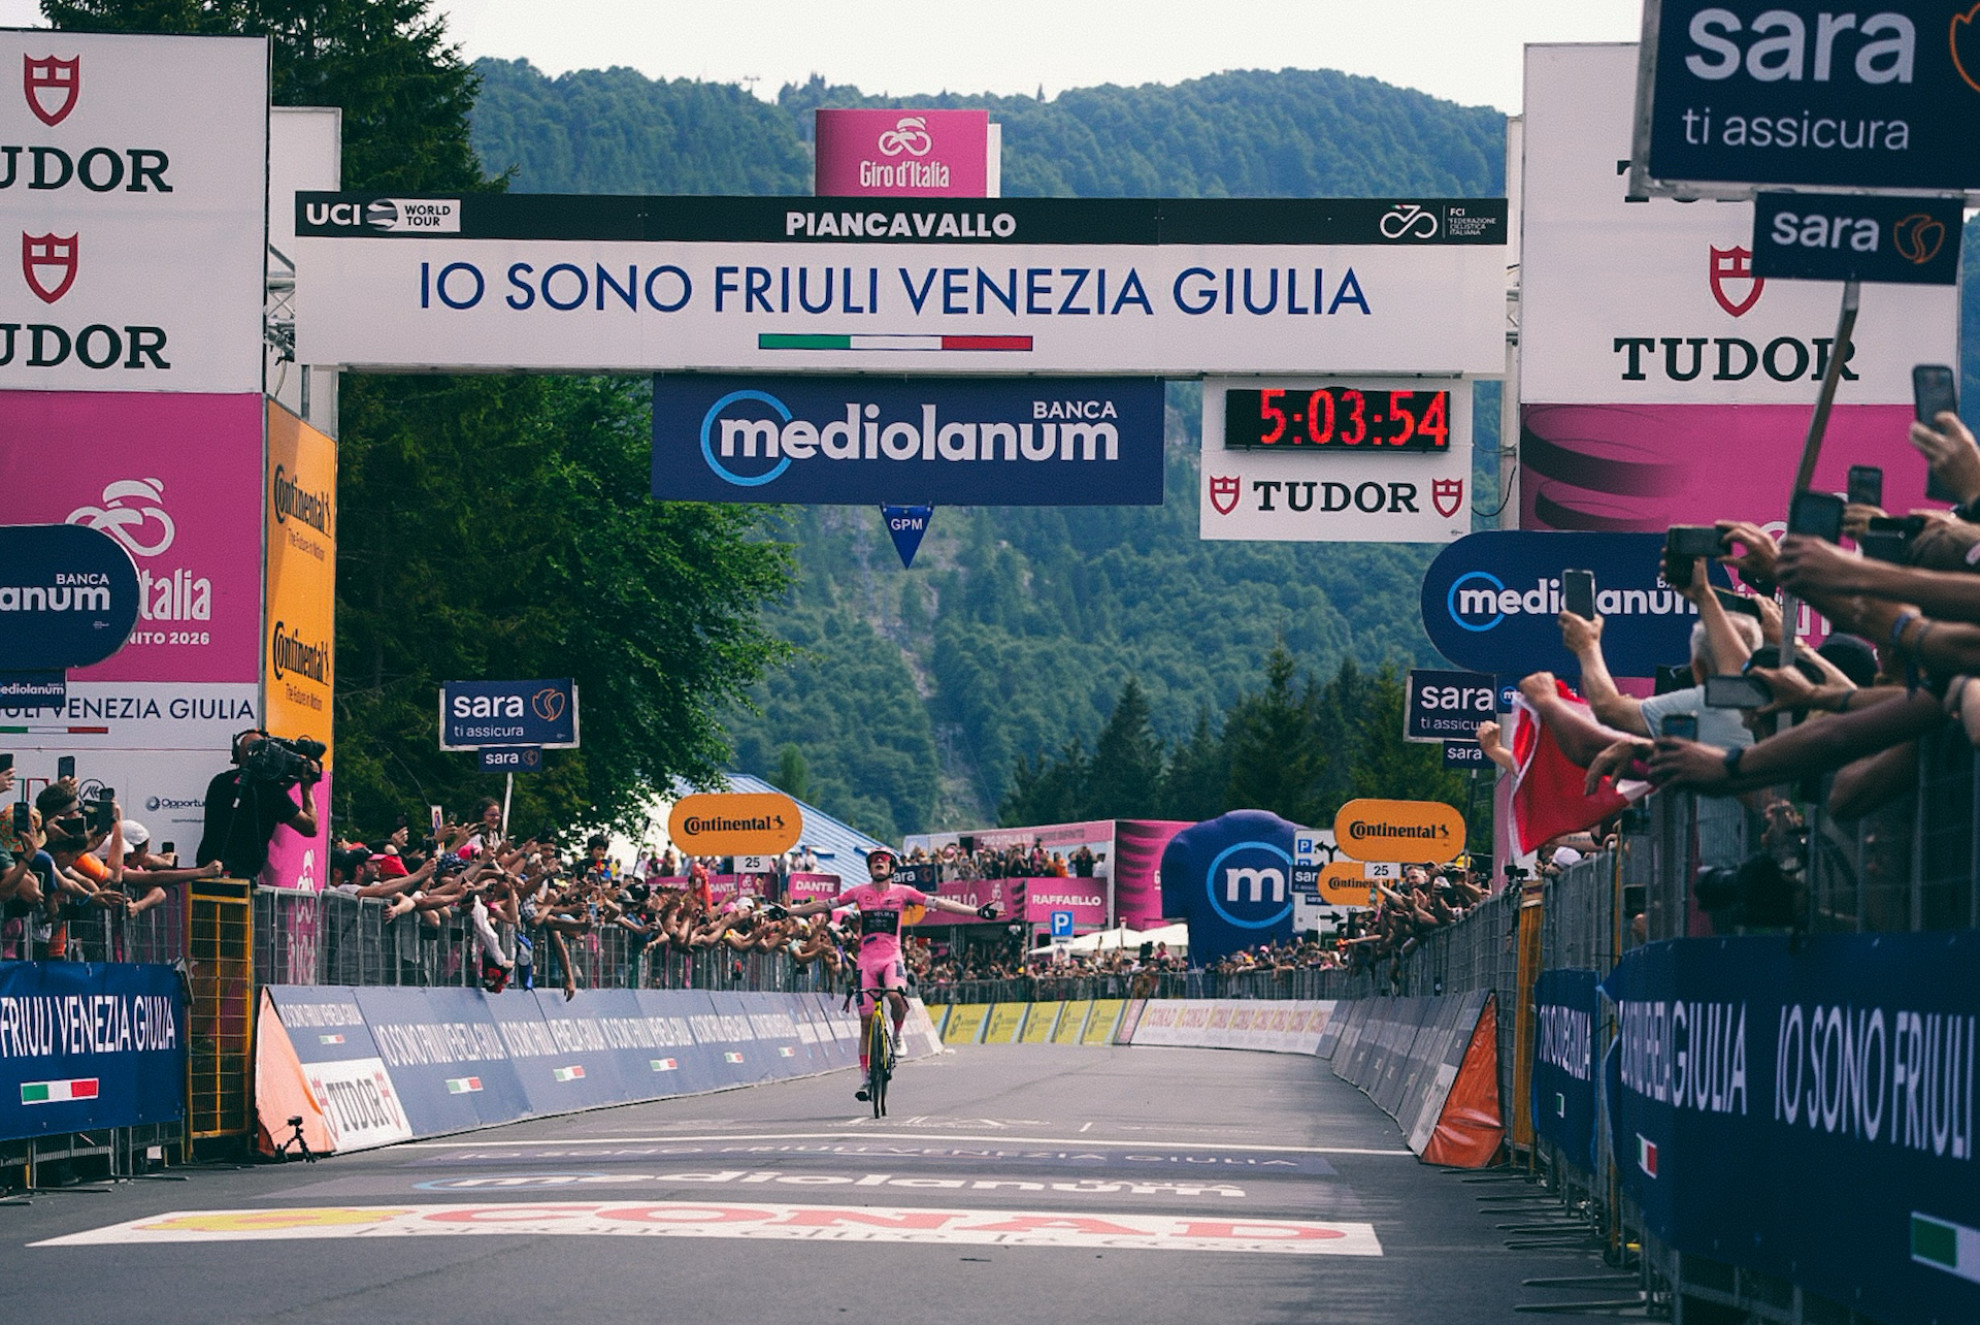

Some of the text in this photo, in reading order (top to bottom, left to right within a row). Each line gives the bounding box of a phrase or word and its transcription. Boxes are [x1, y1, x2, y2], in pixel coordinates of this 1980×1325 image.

[1685, 8, 1916, 84] sara
[1682, 107, 1910, 150] ti assicura
[860, 160, 950, 188] Giro d'Italia
[305, 202, 360, 226] UCI
[404, 205, 451, 216] WORLD
[407, 216, 441, 227] TOUR
[1450, 208, 1465, 216] FCI
[786, 212, 1016, 238] PIANCAVALLO
[1771, 211, 1880, 251] sara
[421, 262, 1372, 316] IO SONO FRIULI VENEZIA GIULIA
[1613, 336, 1859, 382] TUDOR
[1033, 400, 1118, 419] BANCA
[1260, 388, 1449, 446] 5:03:54
[719, 402, 1120, 462] mediolanum
[274, 463, 325, 534] Continental
[1253, 481, 1419, 513] TUDOR
[890, 518, 923, 532] GPM
[56, 573, 110, 585] BANCA
[1459, 578, 1698, 615] medianu
[170, 632, 210, 645] 2026
[273, 620, 324, 683] Continental
[169, 698, 255, 719] GIULIA
[453, 695, 524, 718] sara
[1420, 685, 1495, 712] sara
[454, 725, 524, 738] ti assicura
[1421, 717, 1479, 730] ti assicu
[485, 752, 519, 765] sara
[1447, 747, 1483, 760] sara
[684, 815, 770, 835] Continental
[1350, 820, 1436, 839] Continental
[1300, 840, 1310, 852] P
[745, 857, 760, 868] 25
[1374, 865, 1389, 876] 25
[795, 880, 835, 893] DANTE
[893, 871, 916, 883] ara
[1226, 867, 1285, 902] m
[1295, 871, 1317, 882] sar
[1032, 894, 1101, 906] RAFFAELLO
[1054, 914, 1069, 934] P
[1, 994, 176, 1058] FRIULI VENEZIA GIULIA
[1672, 999, 1747, 1116] GIULIA
[1775, 1004, 1804, 1125] IO
[1807, 1004, 1886, 1141] SONO
[1891, 1010, 1975, 1161] FRIULI
[326, 1078, 390, 1133] TUDOR
[449, 1170, 1247, 1197] mediolanum
[422, 1205, 1347, 1241] CONAD
